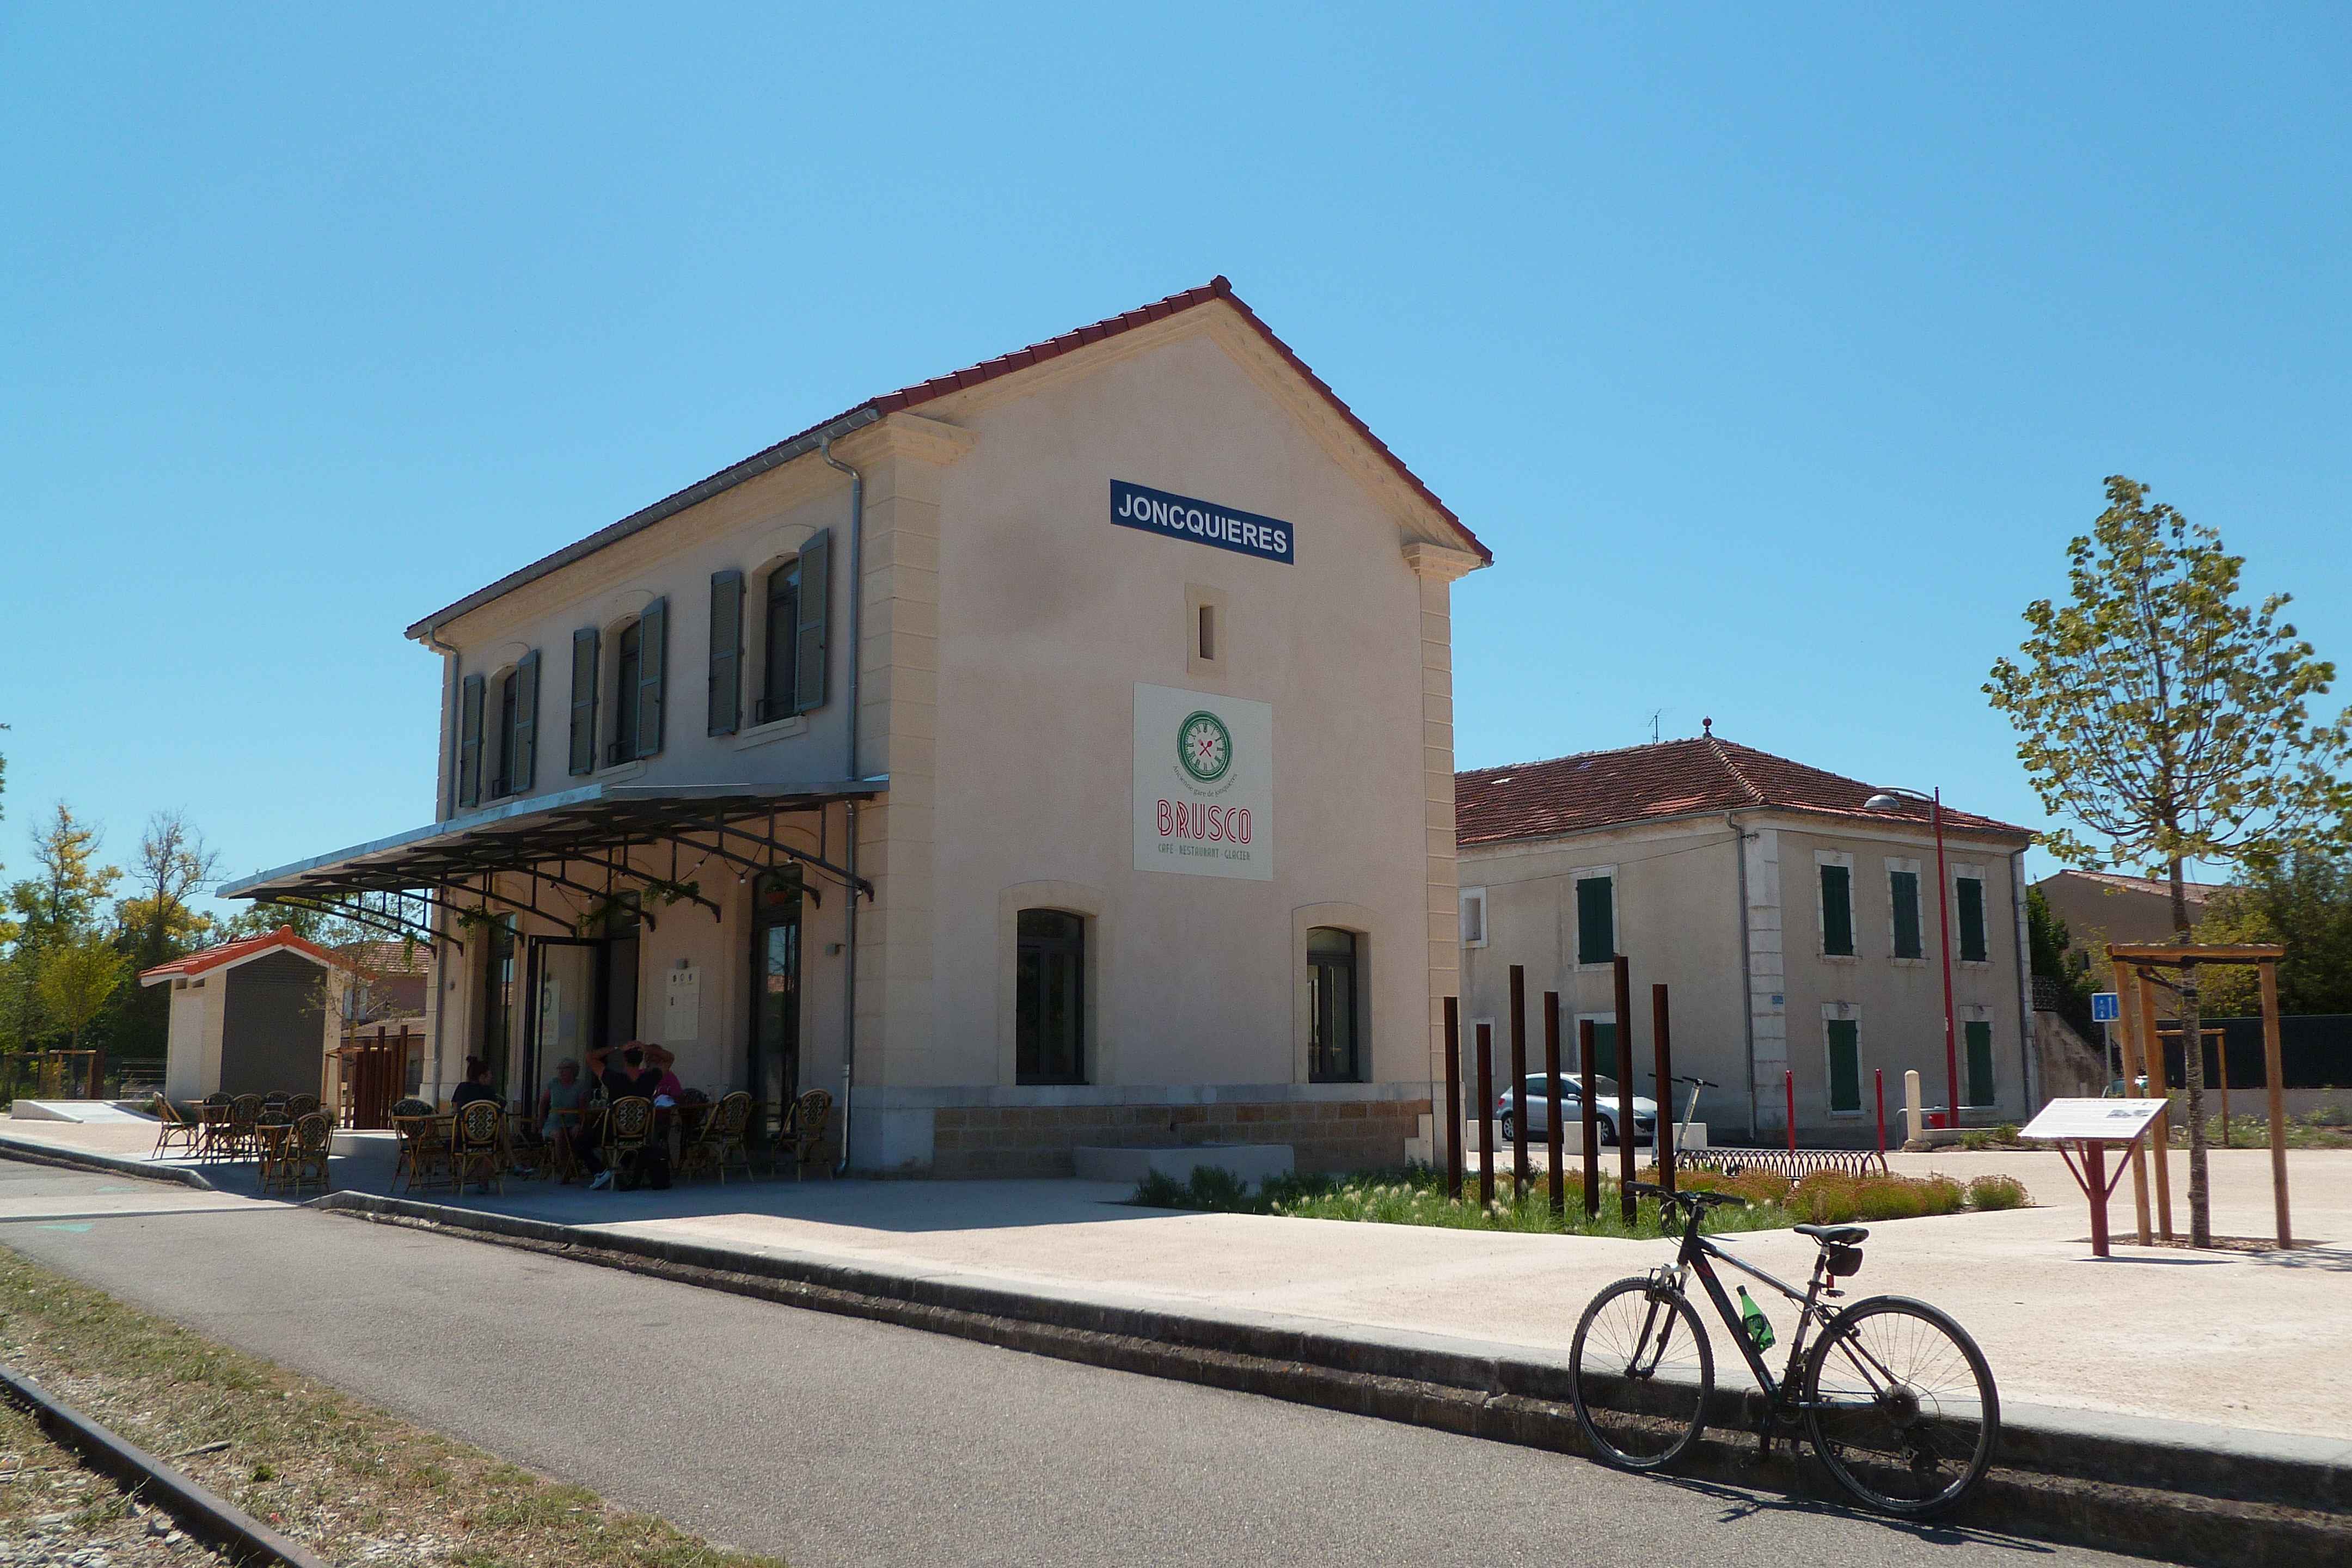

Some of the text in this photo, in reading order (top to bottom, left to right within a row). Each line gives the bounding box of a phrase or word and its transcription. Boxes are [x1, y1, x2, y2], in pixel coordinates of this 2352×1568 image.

[1118, 494, 1287, 553] JONCQUIERES
[1173, 765, 1193, 791] Ancienne
[1193, 789, 1206, 797] gare
[1157, 799, 1251, 844] BRUSCO
[1179, 845, 1219, 857] RESTAURANT
[1224, 849, 1251, 861] GLACIER
